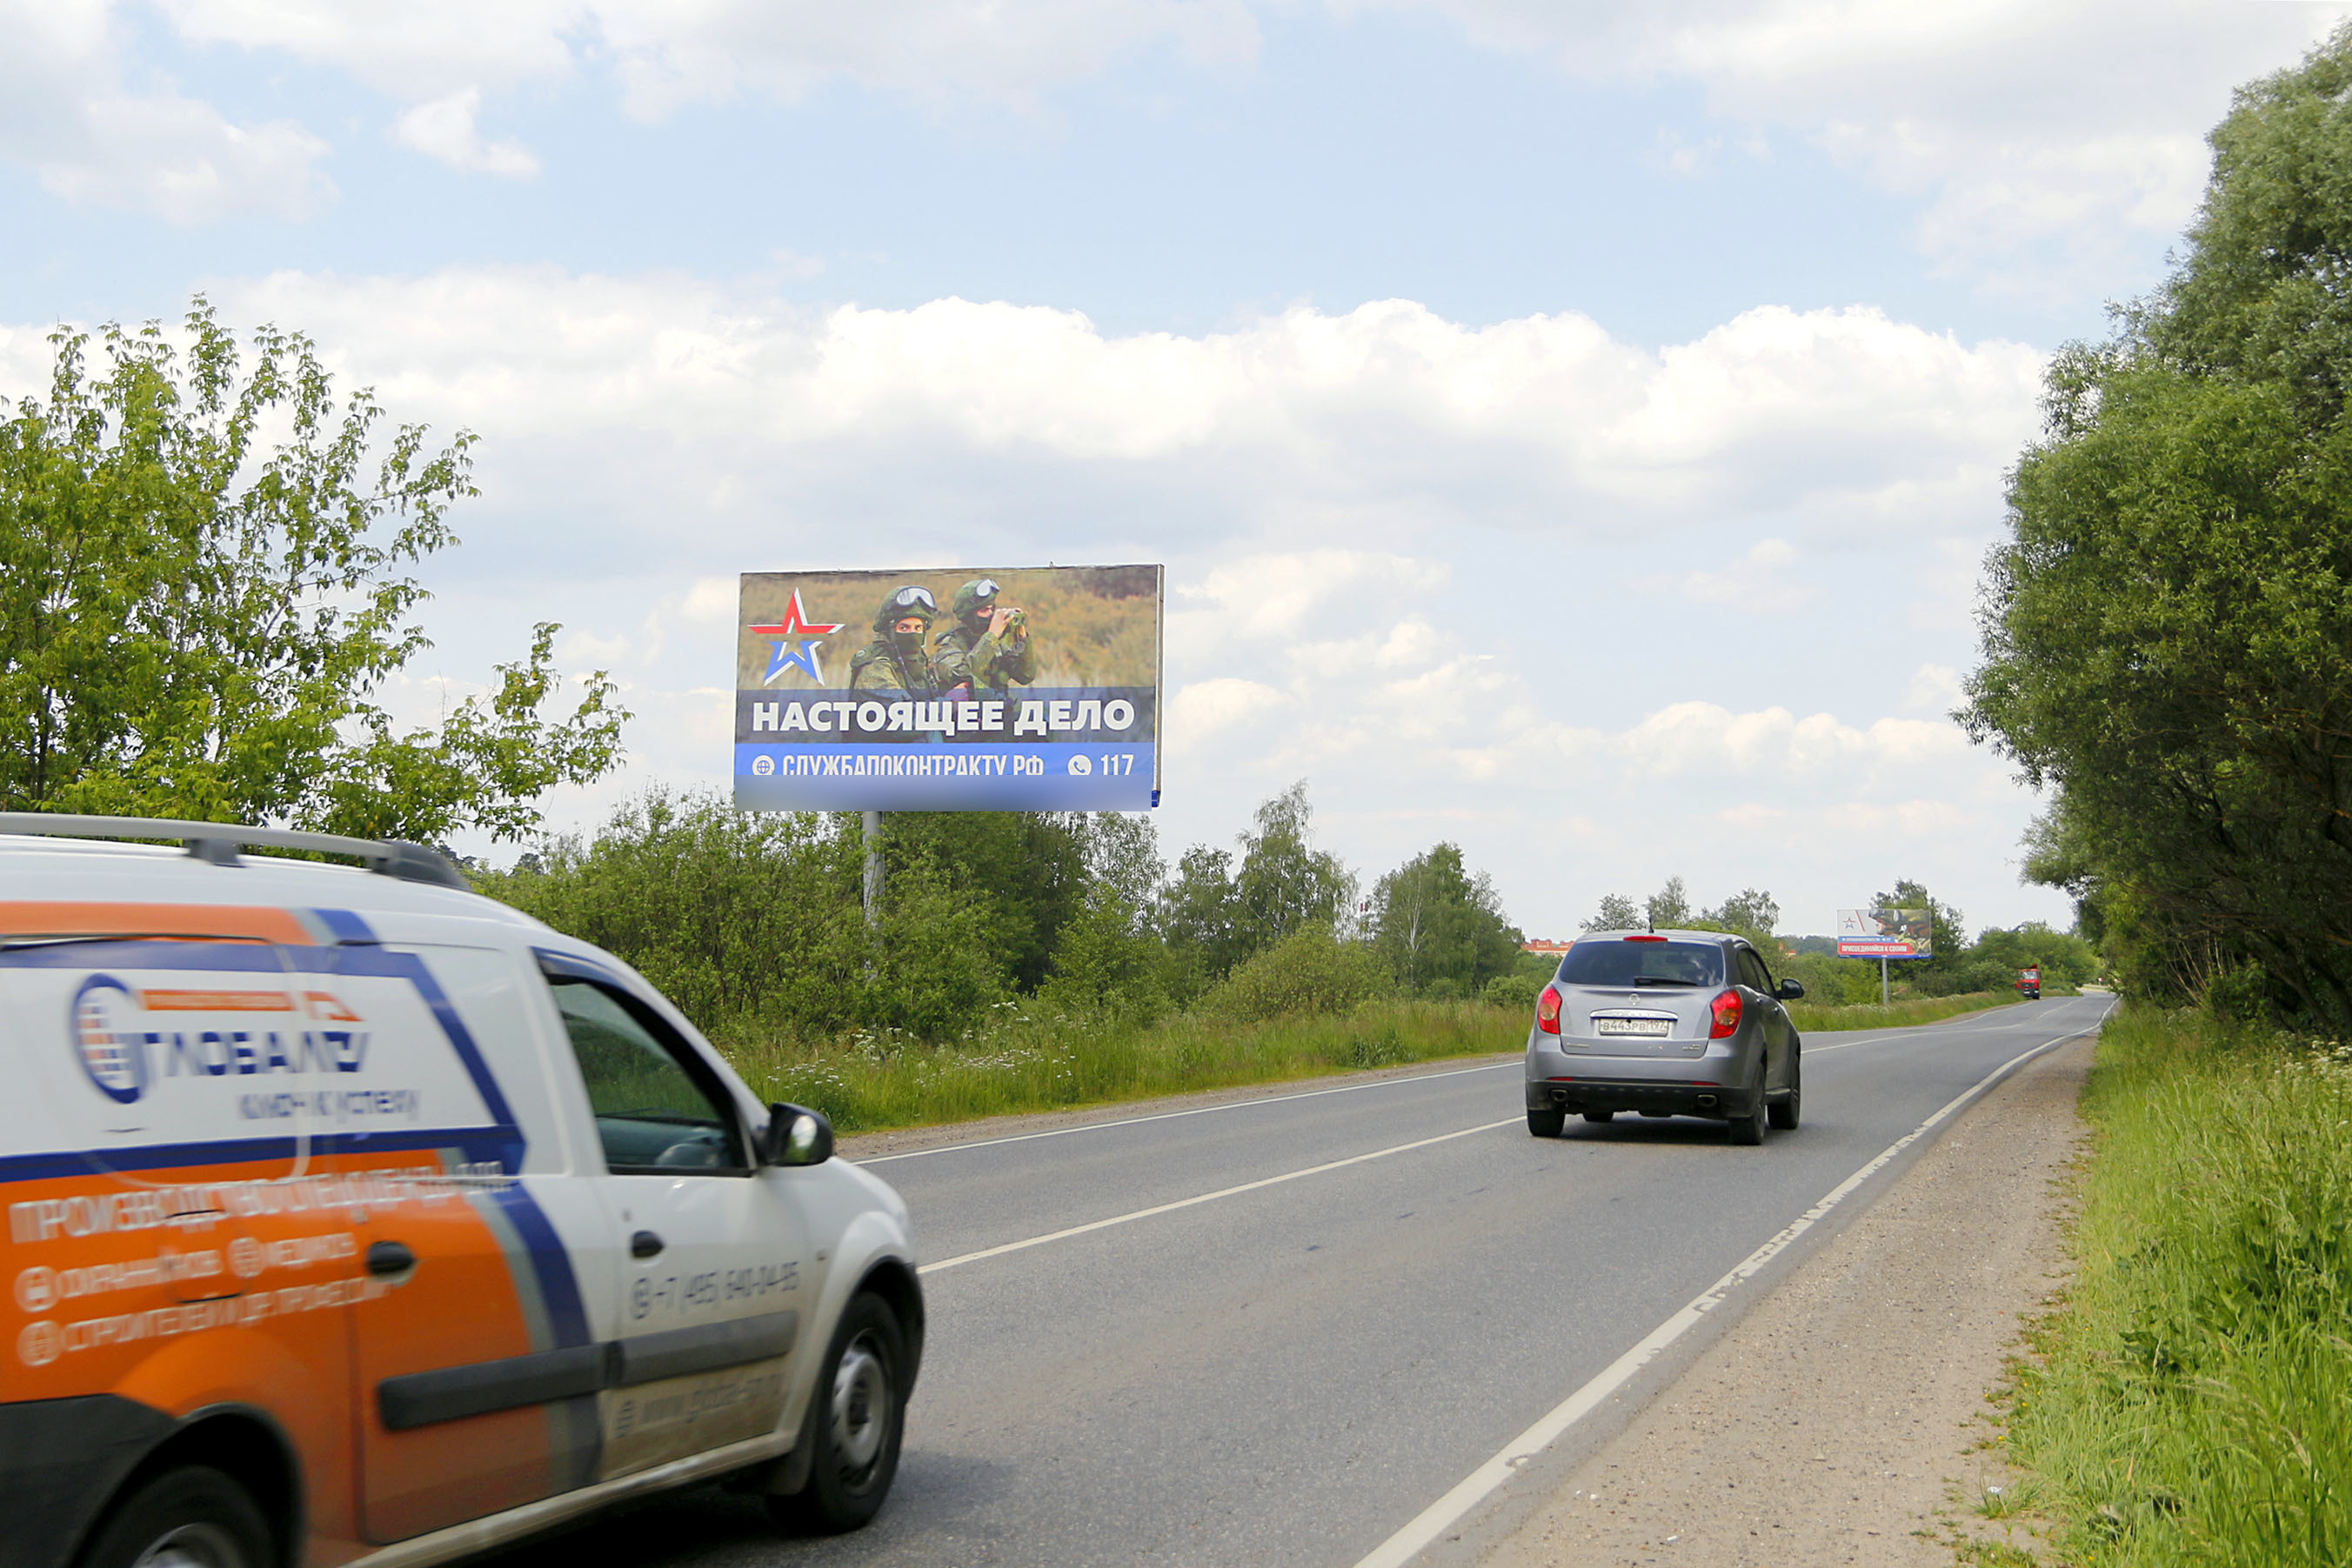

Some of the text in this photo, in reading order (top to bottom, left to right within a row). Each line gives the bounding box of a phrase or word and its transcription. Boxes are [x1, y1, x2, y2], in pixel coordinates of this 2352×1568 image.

[752, 699, 1135, 737] НАСТОЯЩЕЕ ДЕЛО
[1100, 753, 1134, 776] 117
